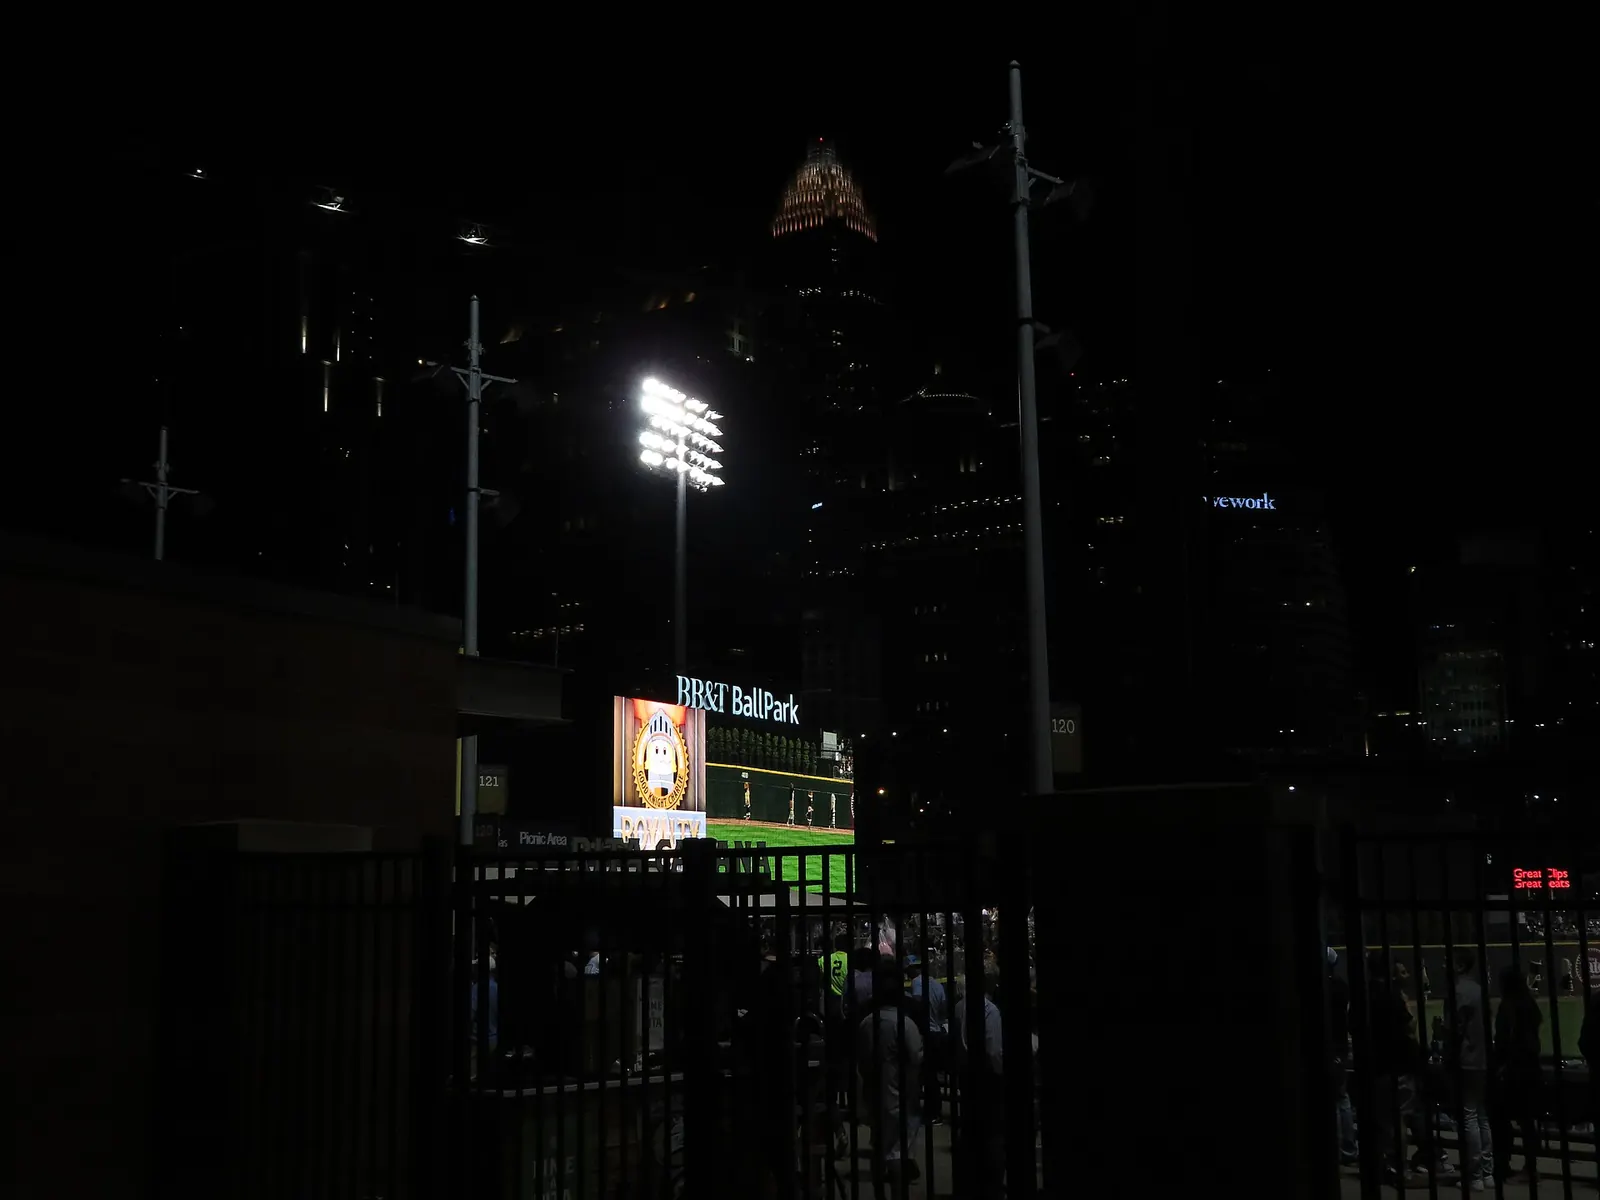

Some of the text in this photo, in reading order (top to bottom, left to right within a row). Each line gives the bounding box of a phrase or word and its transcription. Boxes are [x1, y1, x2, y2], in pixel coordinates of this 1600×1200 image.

[676, 674, 800, 725] BB&T BallPark
[1051, 718, 1075, 734] 120
[479, 775, 499, 787] 121
[519, 831, 568, 846] Picnic Area
[1513, 868, 1542, 879] Great
[1547, 880, 1571, 889] eats
